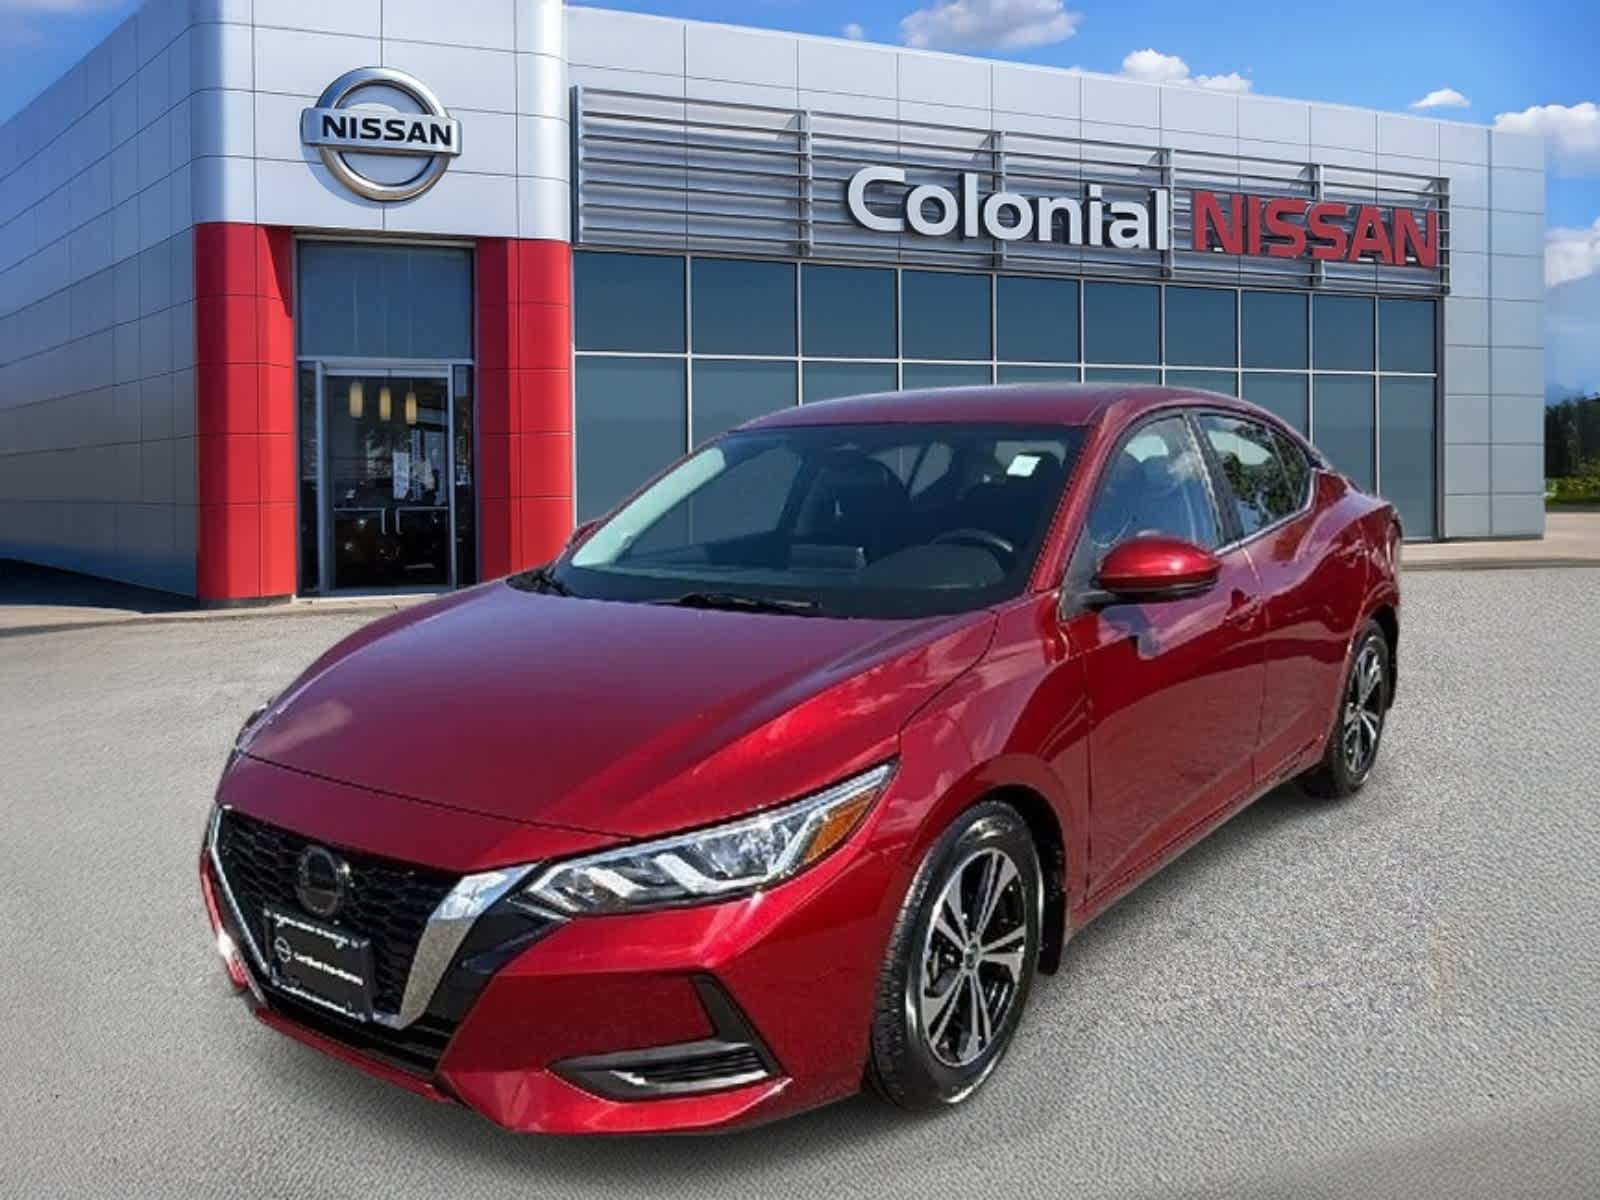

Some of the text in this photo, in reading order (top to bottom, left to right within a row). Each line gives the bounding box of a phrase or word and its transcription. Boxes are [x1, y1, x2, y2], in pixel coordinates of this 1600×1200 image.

[322, 115, 452, 146] NISSAN
[847, 166, 1437, 268] Colonial NISSAN
